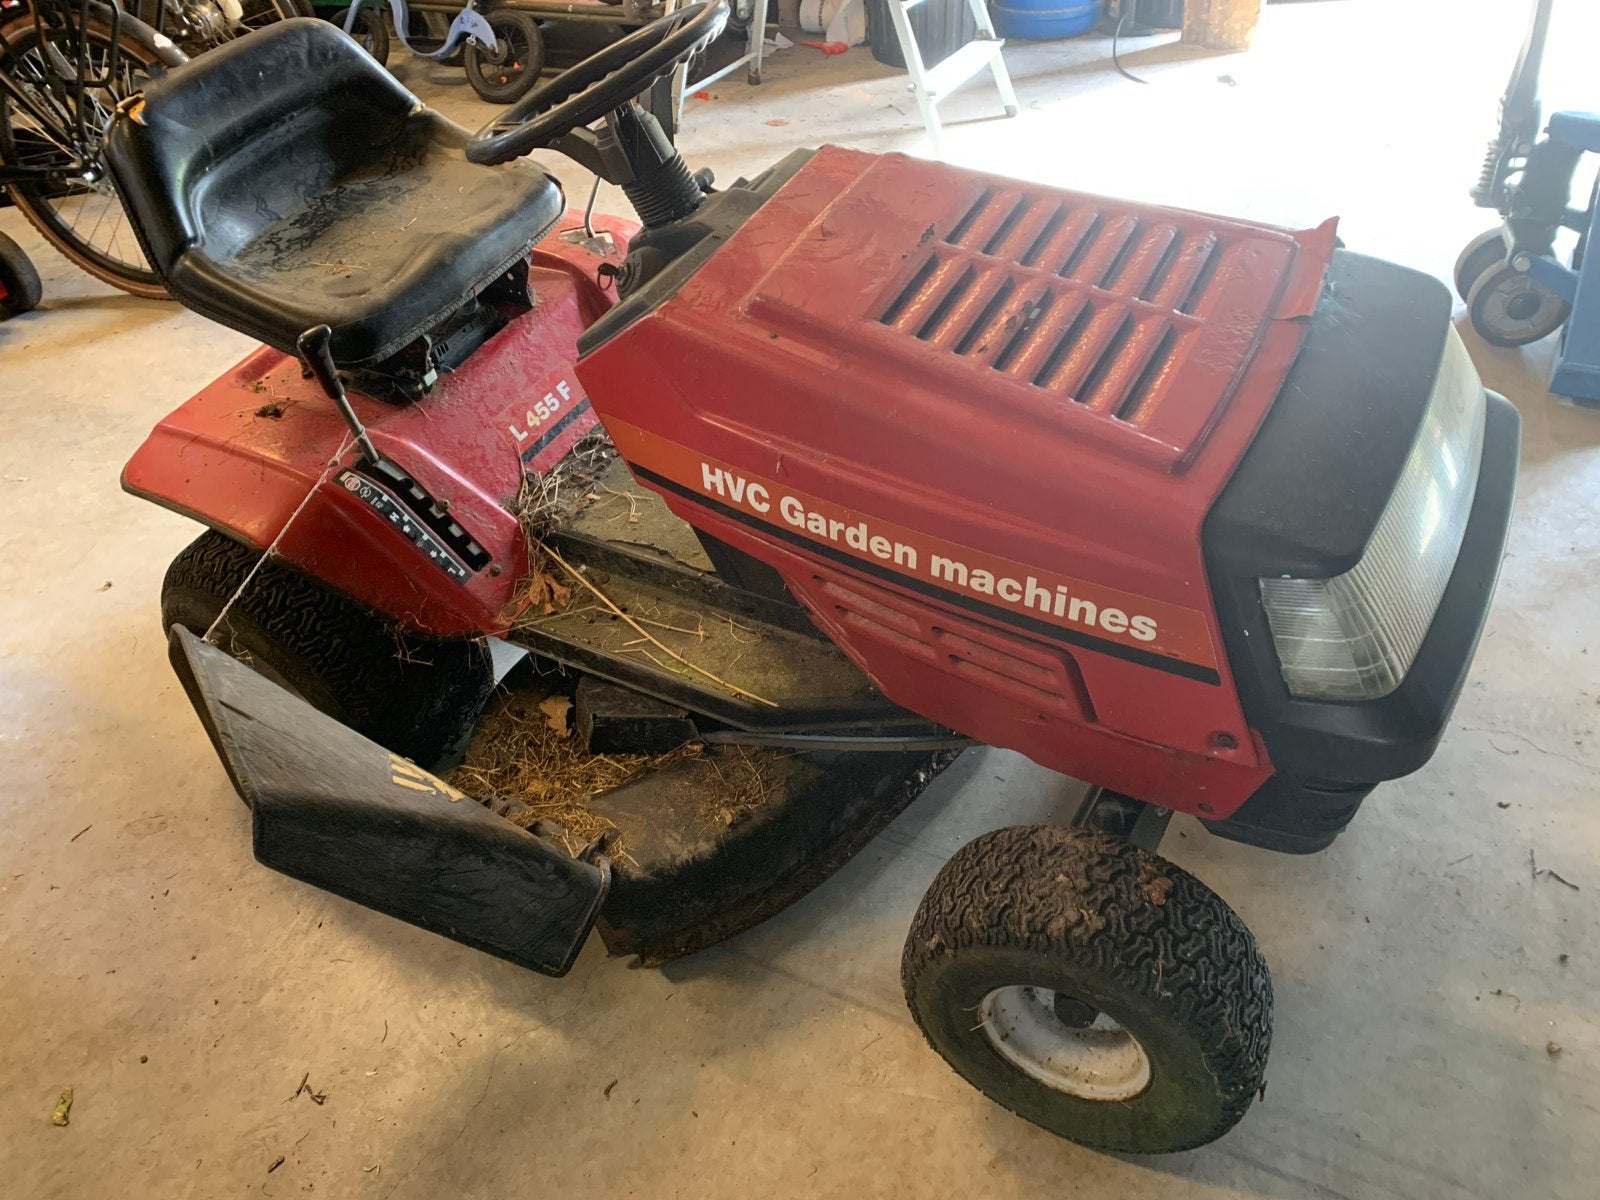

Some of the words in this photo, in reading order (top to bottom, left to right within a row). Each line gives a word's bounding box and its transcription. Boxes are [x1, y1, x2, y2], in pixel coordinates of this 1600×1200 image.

[508, 424, 529, 442] L
[526, 392, 560, 427] 455
[555, 379, 571, 401] F
[701, 462, 771, 513] HVC
[780, 496, 917, 569] Garden
[931, 554, 1158, 642] machines
